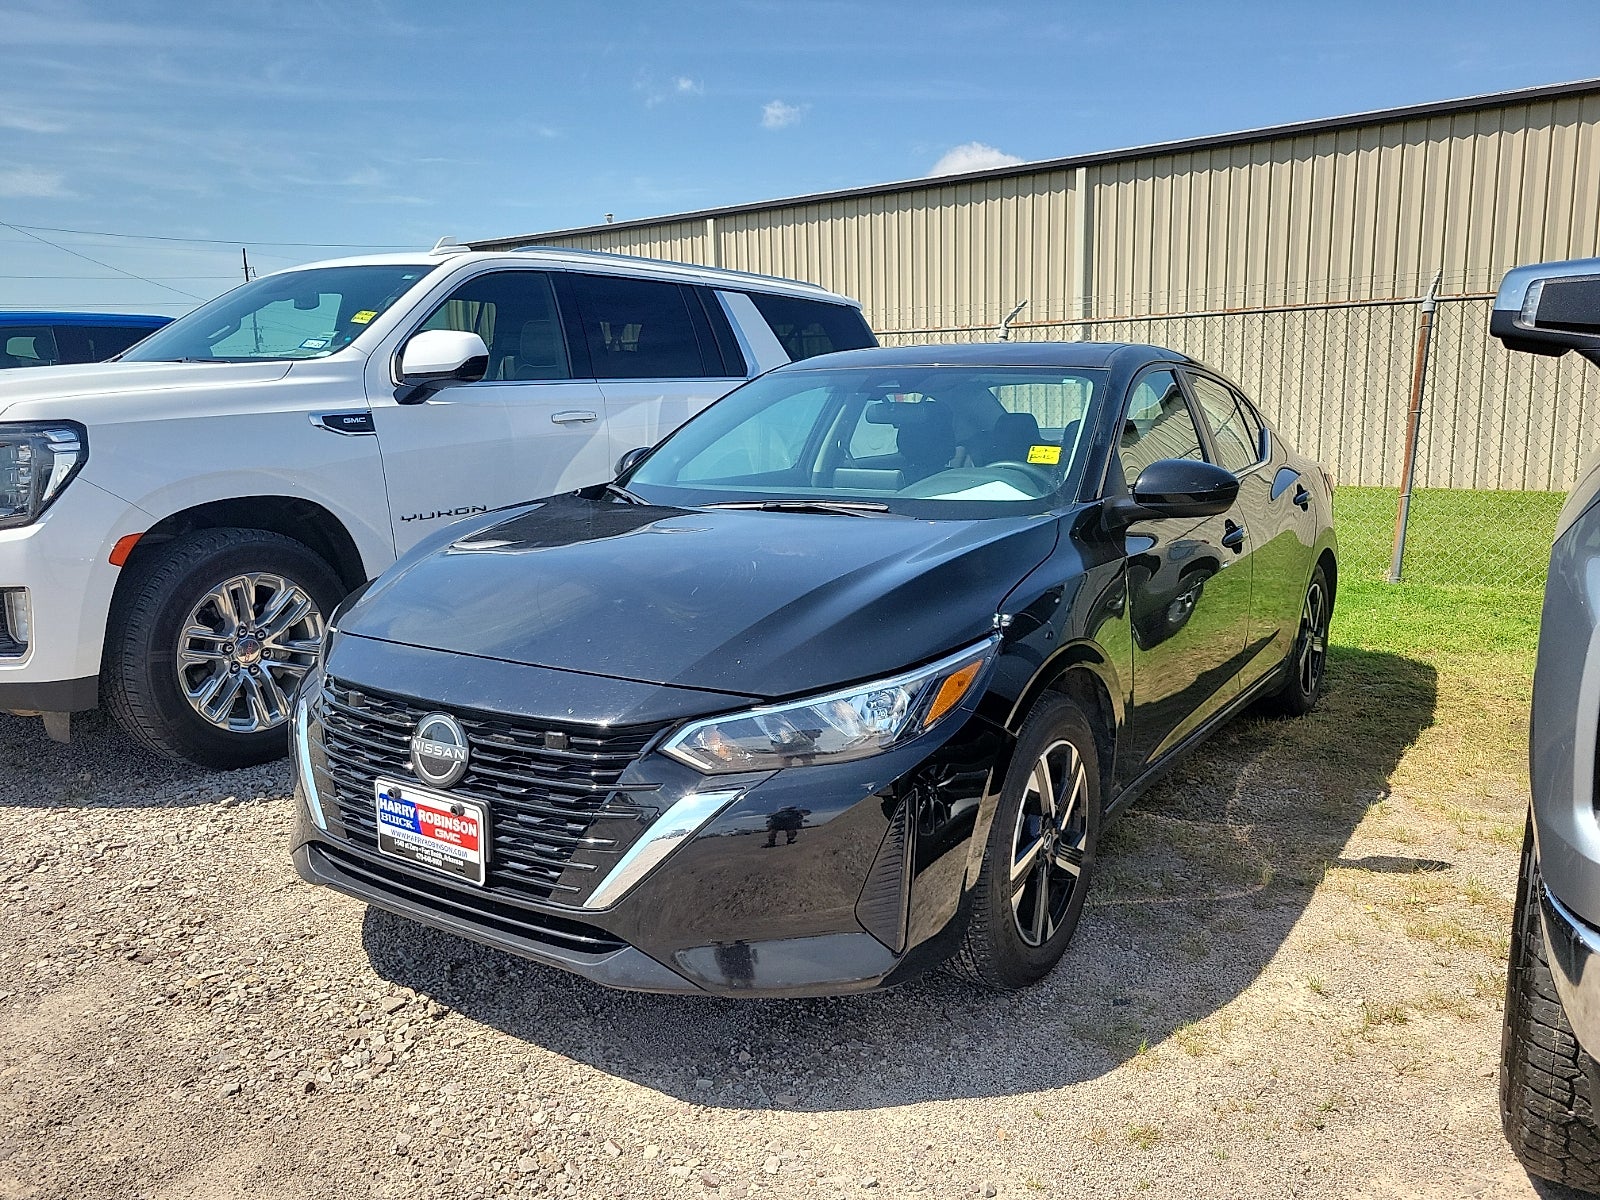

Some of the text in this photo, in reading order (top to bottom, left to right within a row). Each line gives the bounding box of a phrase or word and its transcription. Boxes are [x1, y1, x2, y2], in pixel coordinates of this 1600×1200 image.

[343, 416, 367, 424] GMC
[400, 504, 488, 522] YUKON
[412, 737, 466, 760] NISSAN
[380, 798, 478, 838] HARRY ROBINSON
[381, 812, 462, 844] BUICK GMC
